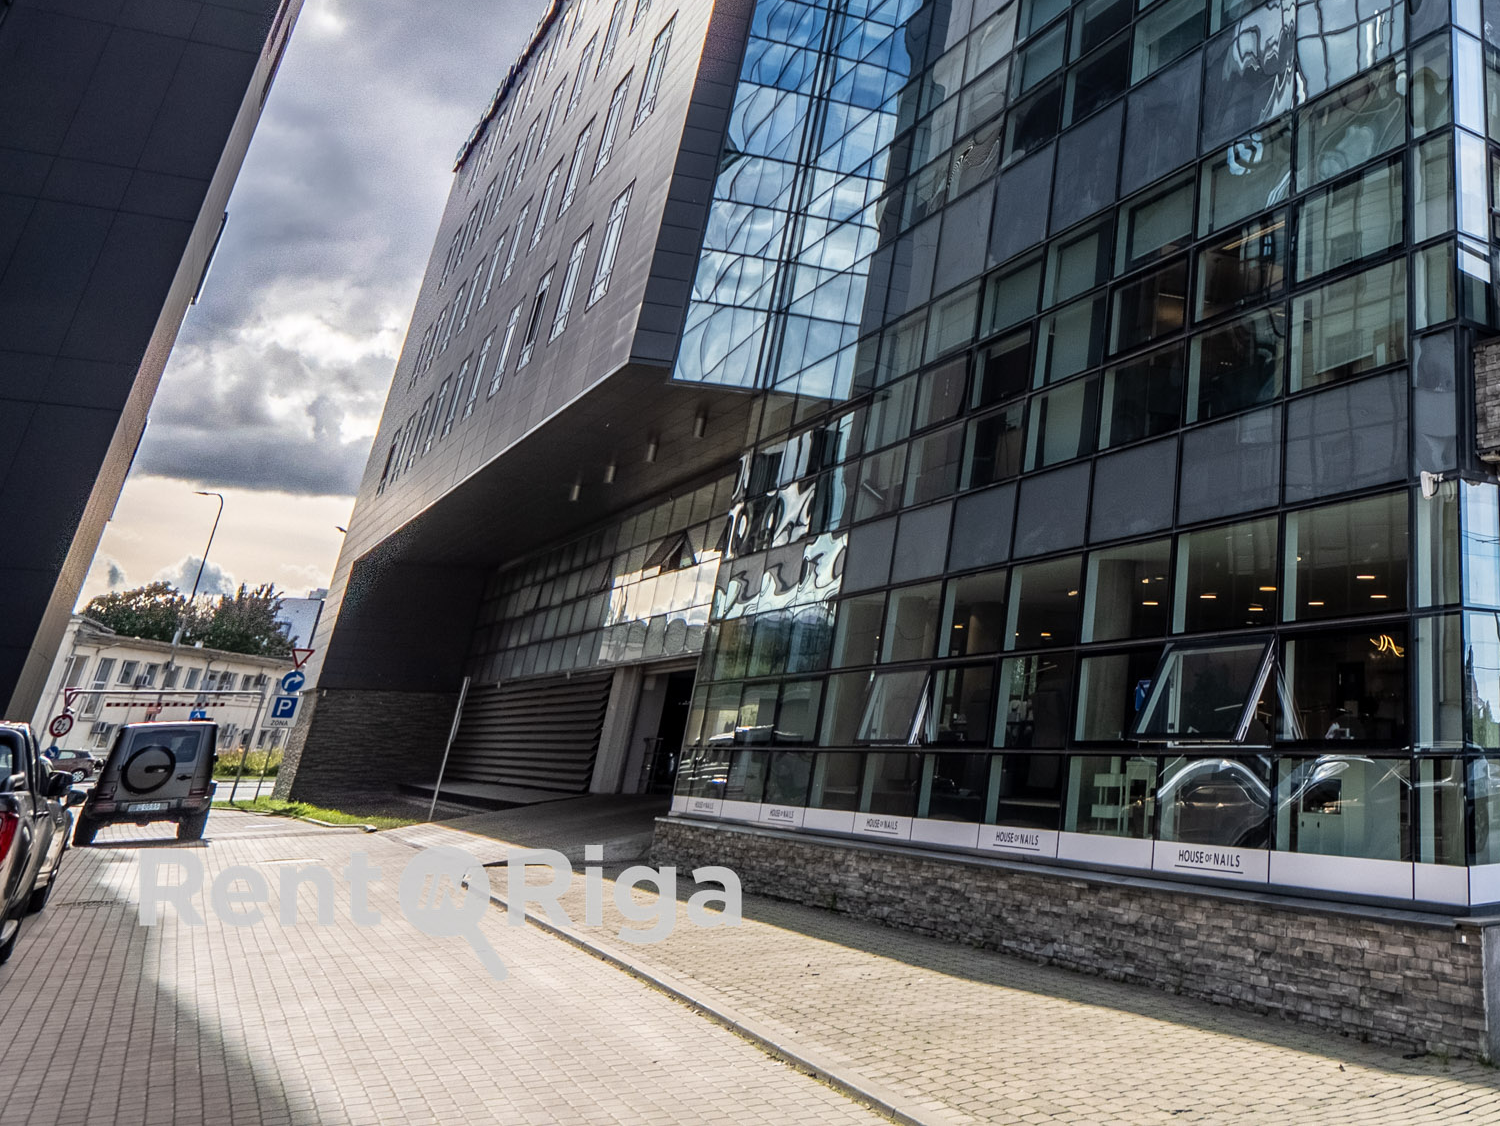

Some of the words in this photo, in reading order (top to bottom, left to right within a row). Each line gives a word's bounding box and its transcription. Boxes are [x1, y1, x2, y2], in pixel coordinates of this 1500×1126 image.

[276, 699, 292, 716] P
[884, 820, 898, 830] NAILS
[995, 830, 1014, 843] HOUSE
[1020, 833, 1039, 846] NAILS
[1178, 849, 1204, 863] HOUSE
[1213, 852, 1240, 868] NAILS
